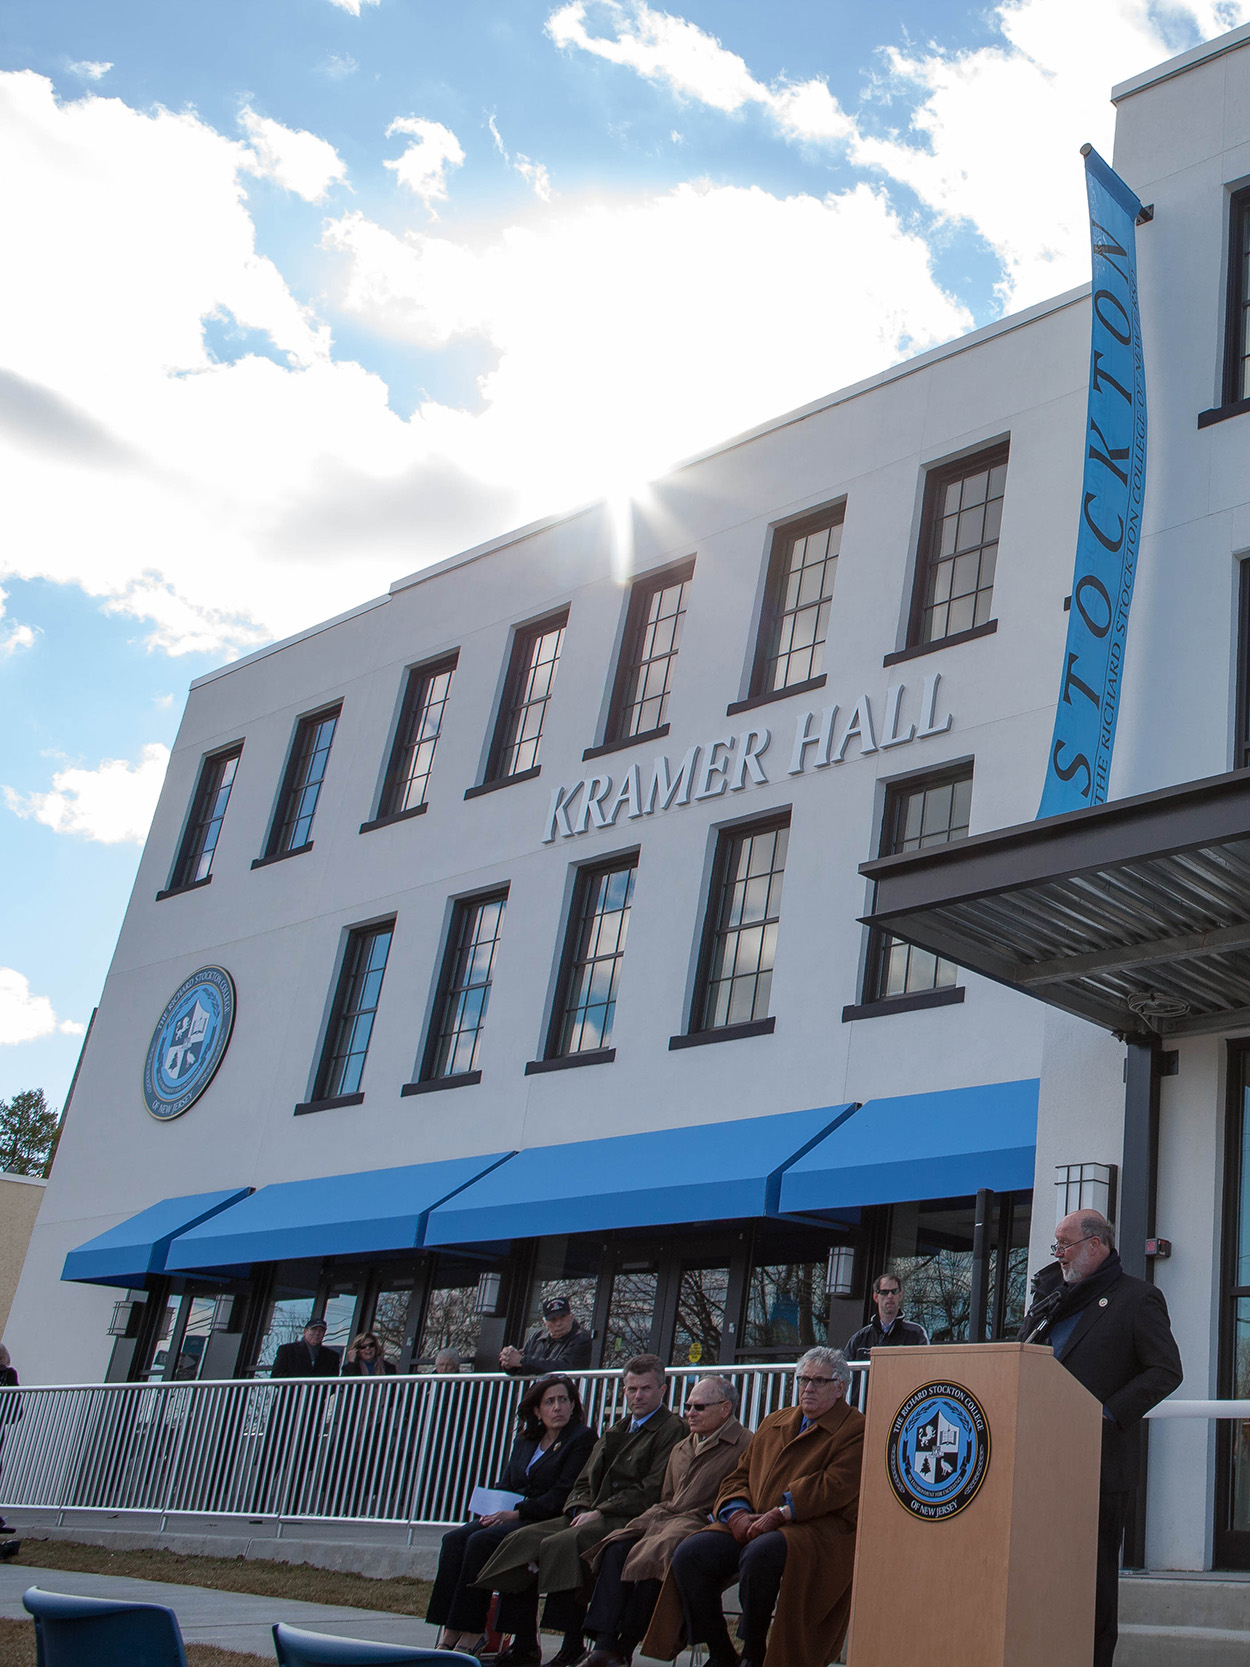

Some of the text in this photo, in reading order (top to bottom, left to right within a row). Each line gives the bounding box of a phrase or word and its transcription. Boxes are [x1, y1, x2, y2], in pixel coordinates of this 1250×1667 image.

[1133, 335, 1143, 373] NEW
[1135, 376, 1145, 408] OF
[1132, 413, 1145, 505] COLLEGE
[1053, 219, 1132, 799] STOCKTON
[1116, 509, 1139, 637] STOCKTON
[1101, 642, 1121, 751] RICHARD
[541, 673, 953, 844] KRAMER HALL
[1094, 755, 1108, 805] THE
[157, 970, 232, 1030] THE RICHARD STOCKTON COLLEGE
[152, 1090, 194, 1115] OF NEW JERSEY
[893, 1385, 986, 1434] THE RICHARD STOCKTON COLLEGE
[910, 1499, 959, 1518] OF NEW JERSEY
